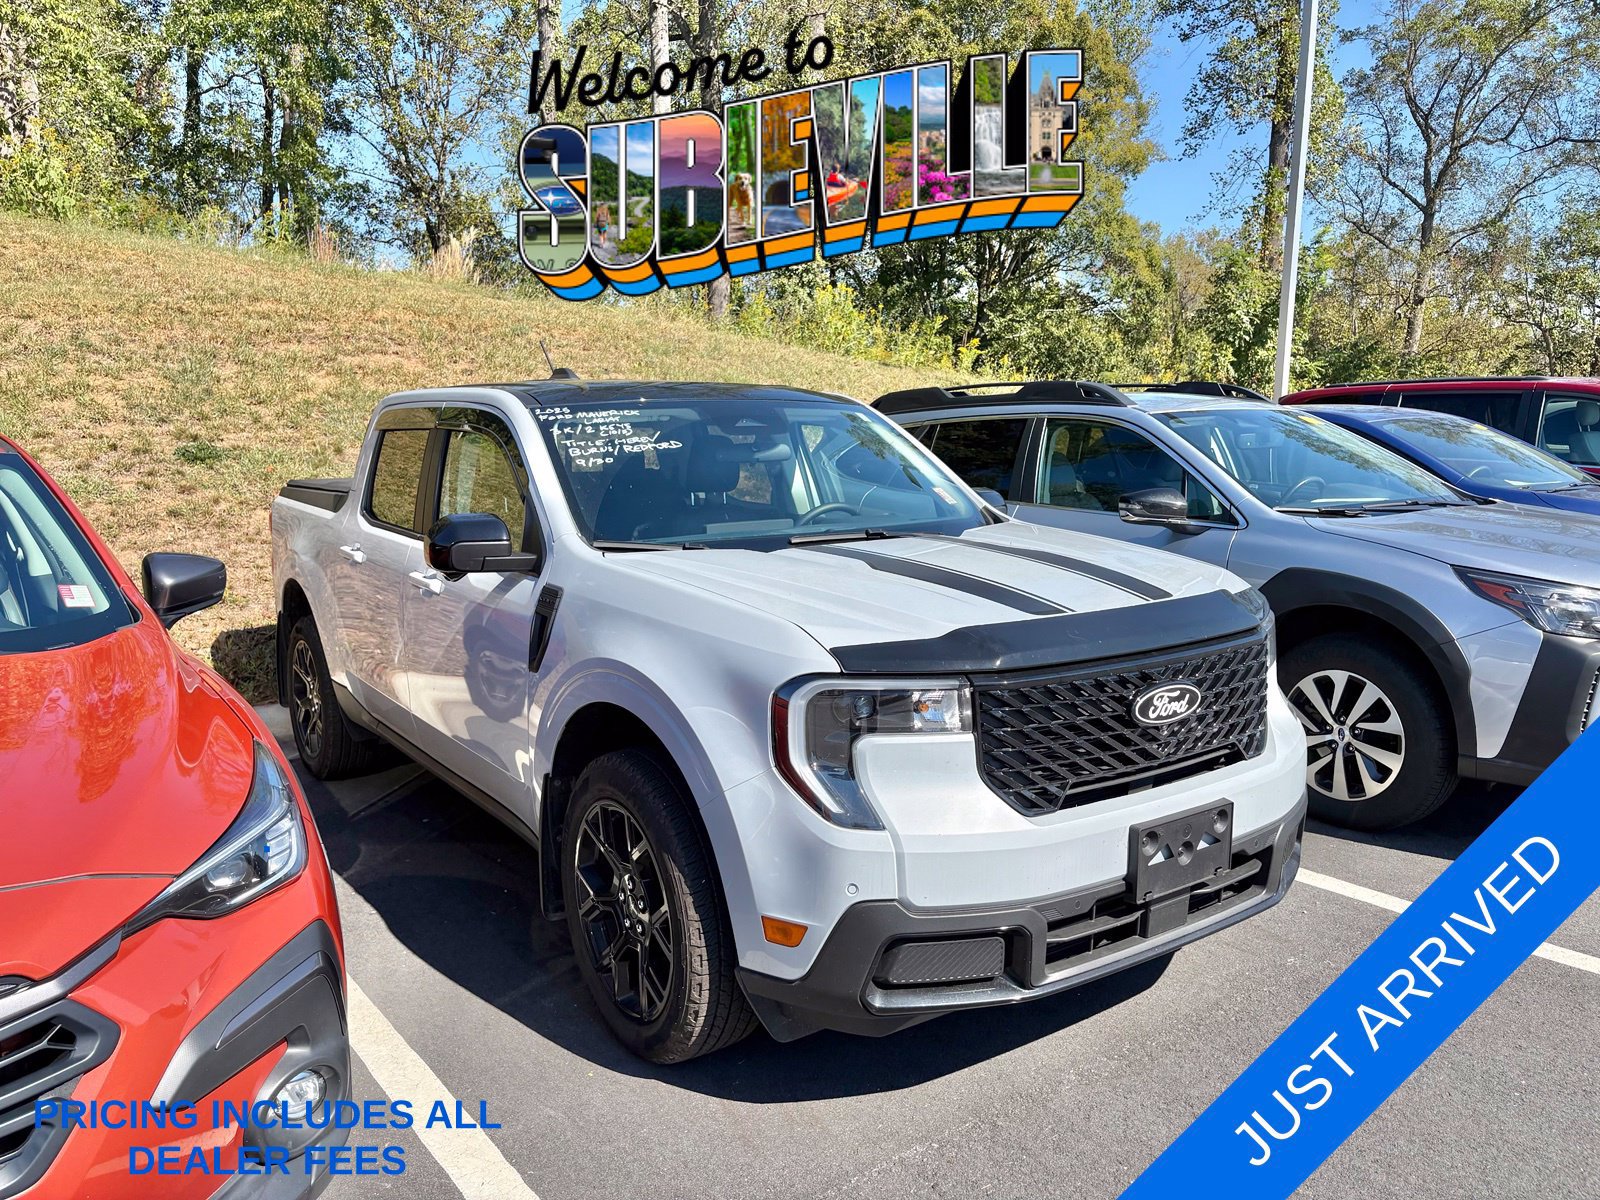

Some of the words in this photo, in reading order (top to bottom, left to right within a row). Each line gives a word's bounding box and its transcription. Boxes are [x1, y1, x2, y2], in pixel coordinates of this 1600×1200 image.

[535, 407, 570, 415] 2025
[538, 414, 573, 422] FORD
[576, 409, 640, 419] MAVERICK
[1148, 690, 1190, 719] Ford
